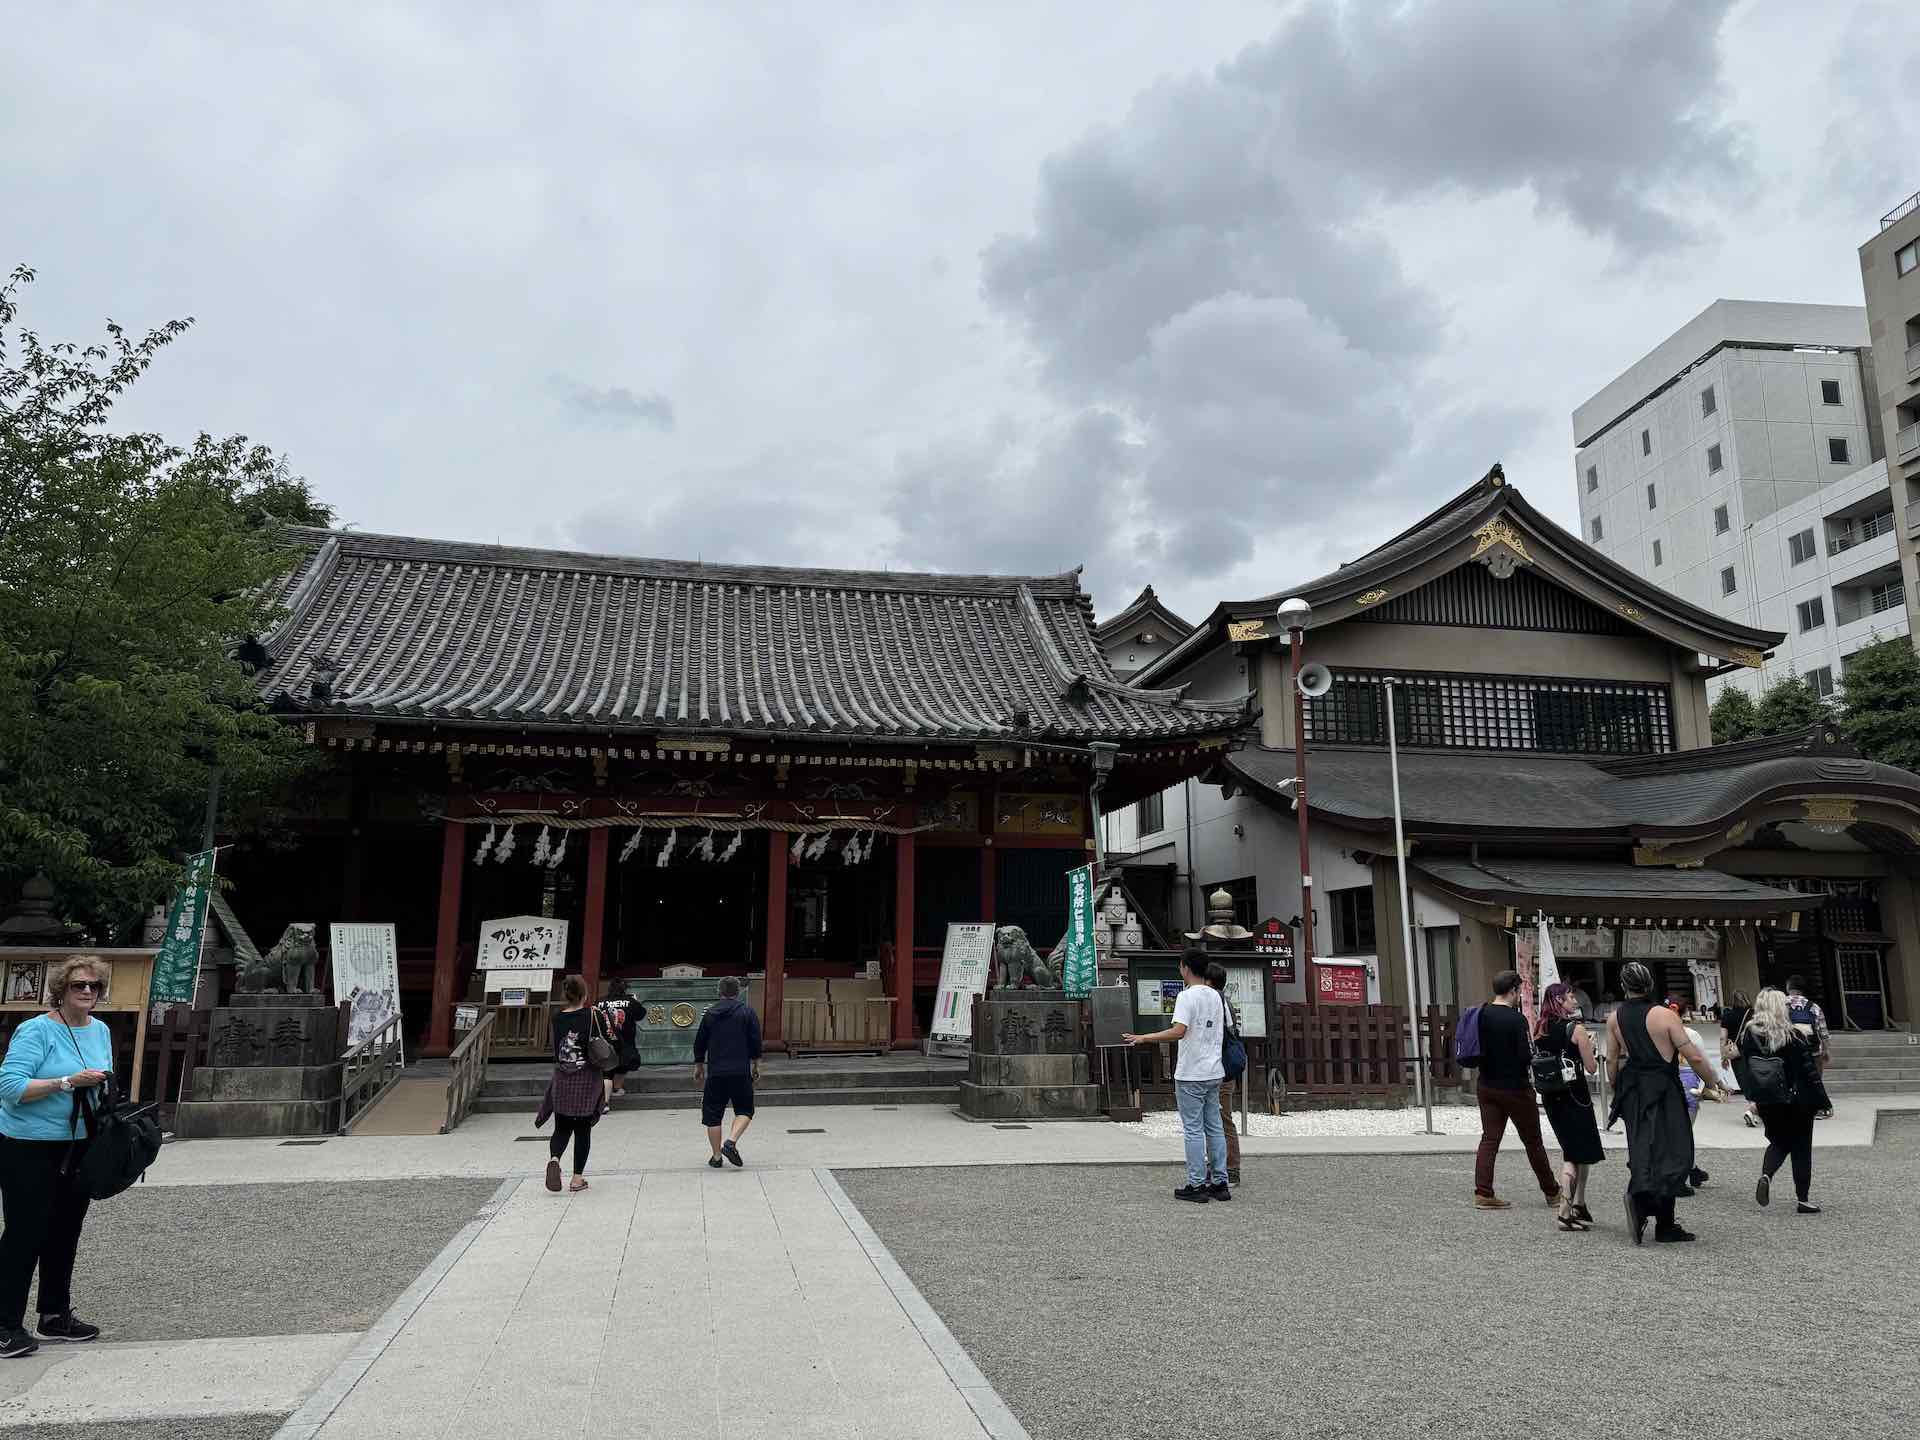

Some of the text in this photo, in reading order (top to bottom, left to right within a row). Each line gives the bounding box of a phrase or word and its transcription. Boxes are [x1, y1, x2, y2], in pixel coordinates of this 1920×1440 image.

[490, 926, 553, 945] がんばろう
